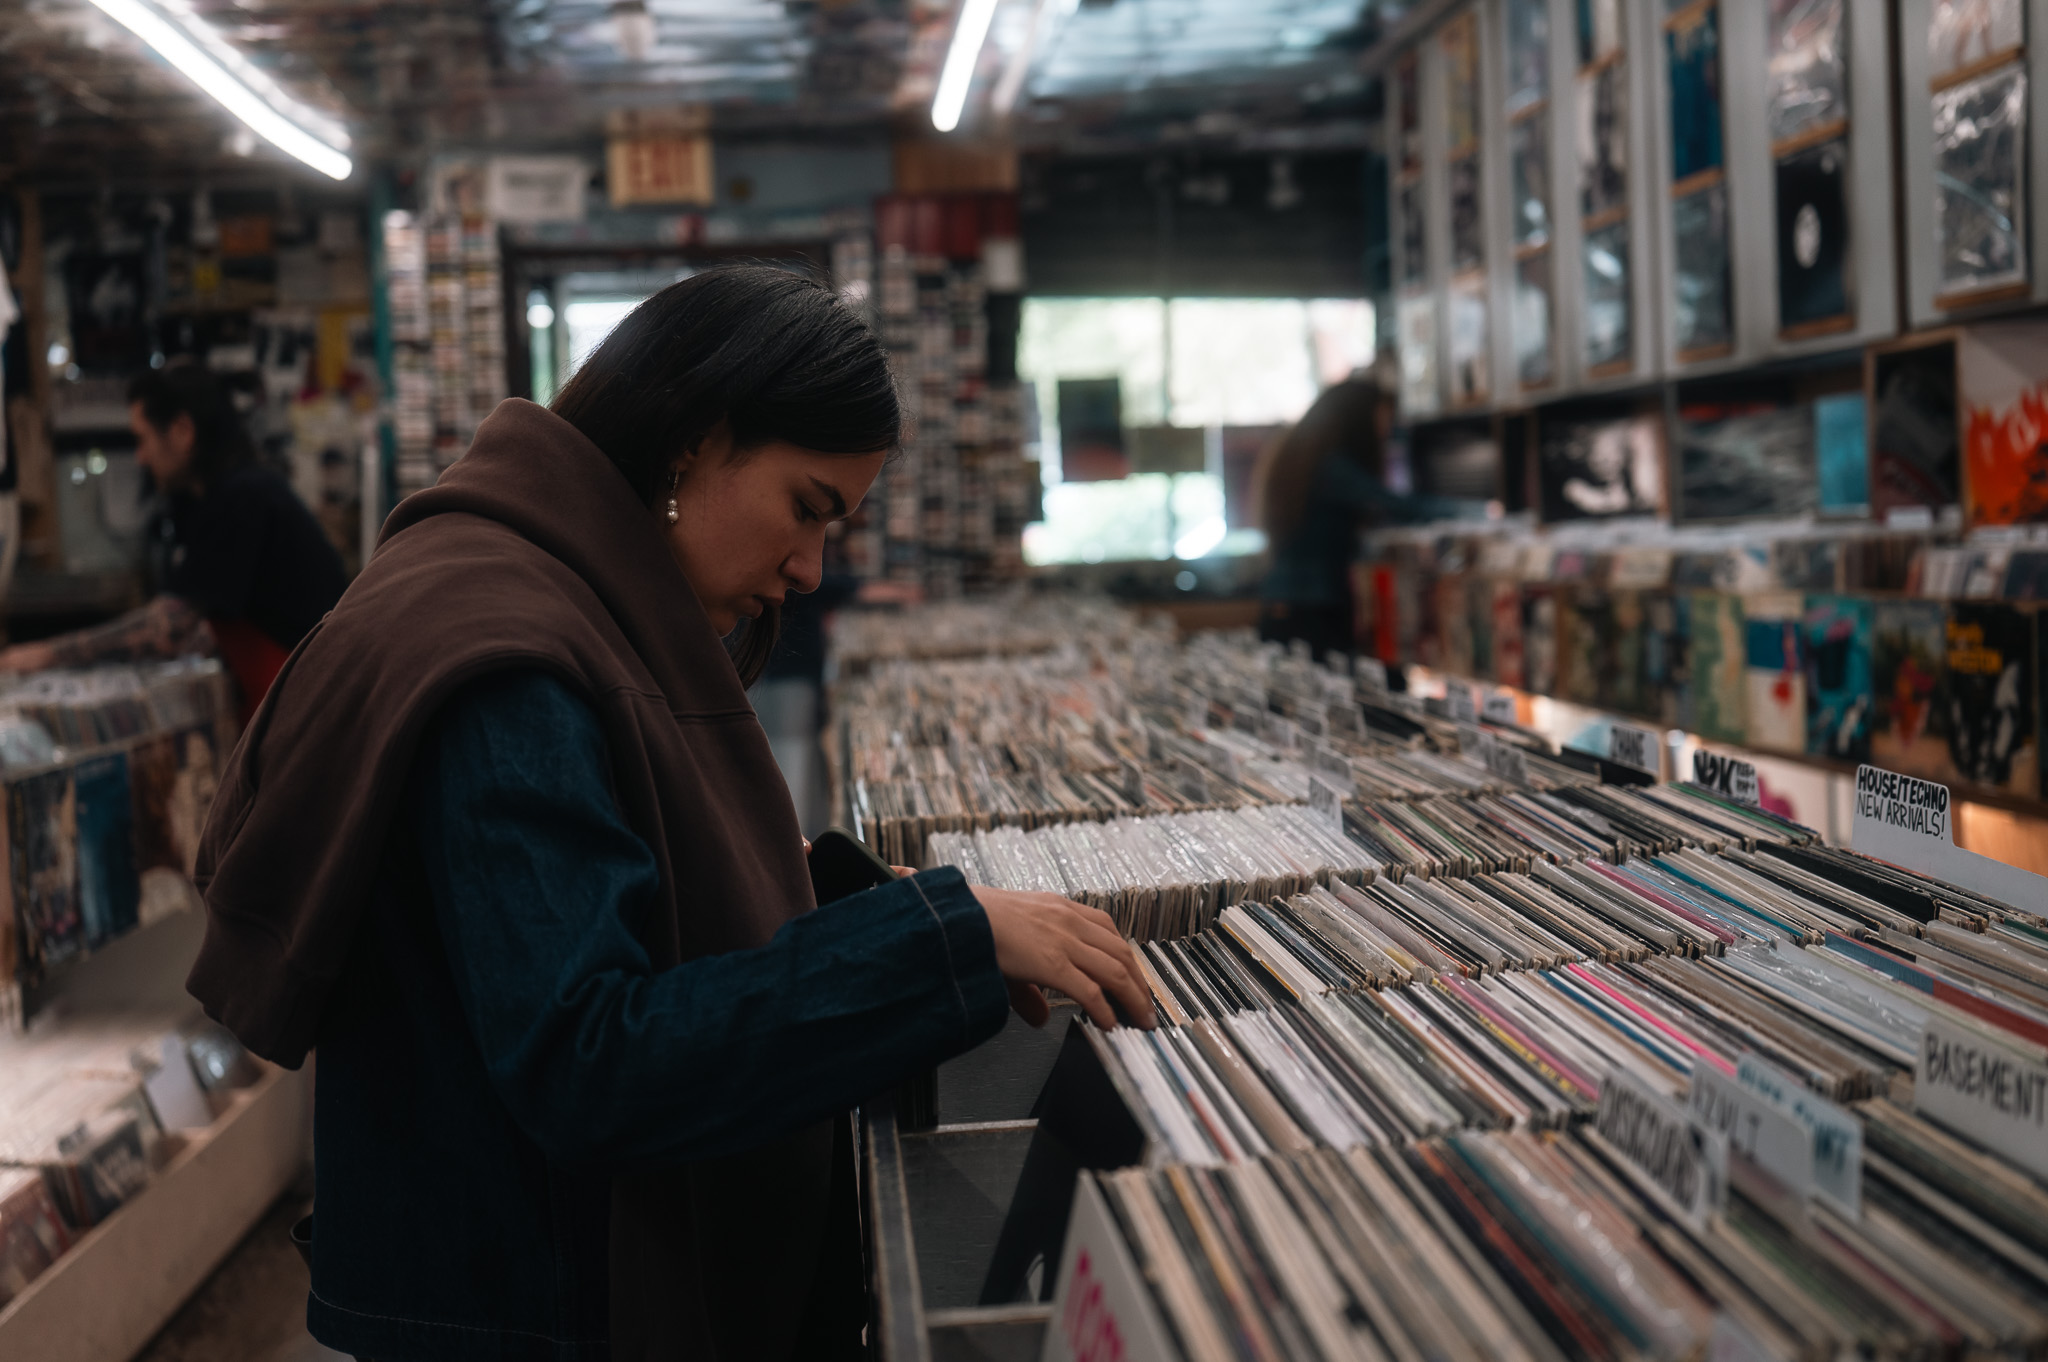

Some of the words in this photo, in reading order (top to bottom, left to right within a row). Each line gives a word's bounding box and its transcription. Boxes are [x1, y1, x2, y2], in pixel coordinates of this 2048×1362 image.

[1858, 766, 1947, 813] HOUSE/TECHNO
[1857, 792, 1884, 821] NEW
[1885, 800, 1945, 840] ARRIVALS!
[1924, 1032, 2048, 1129] BASEMENT
